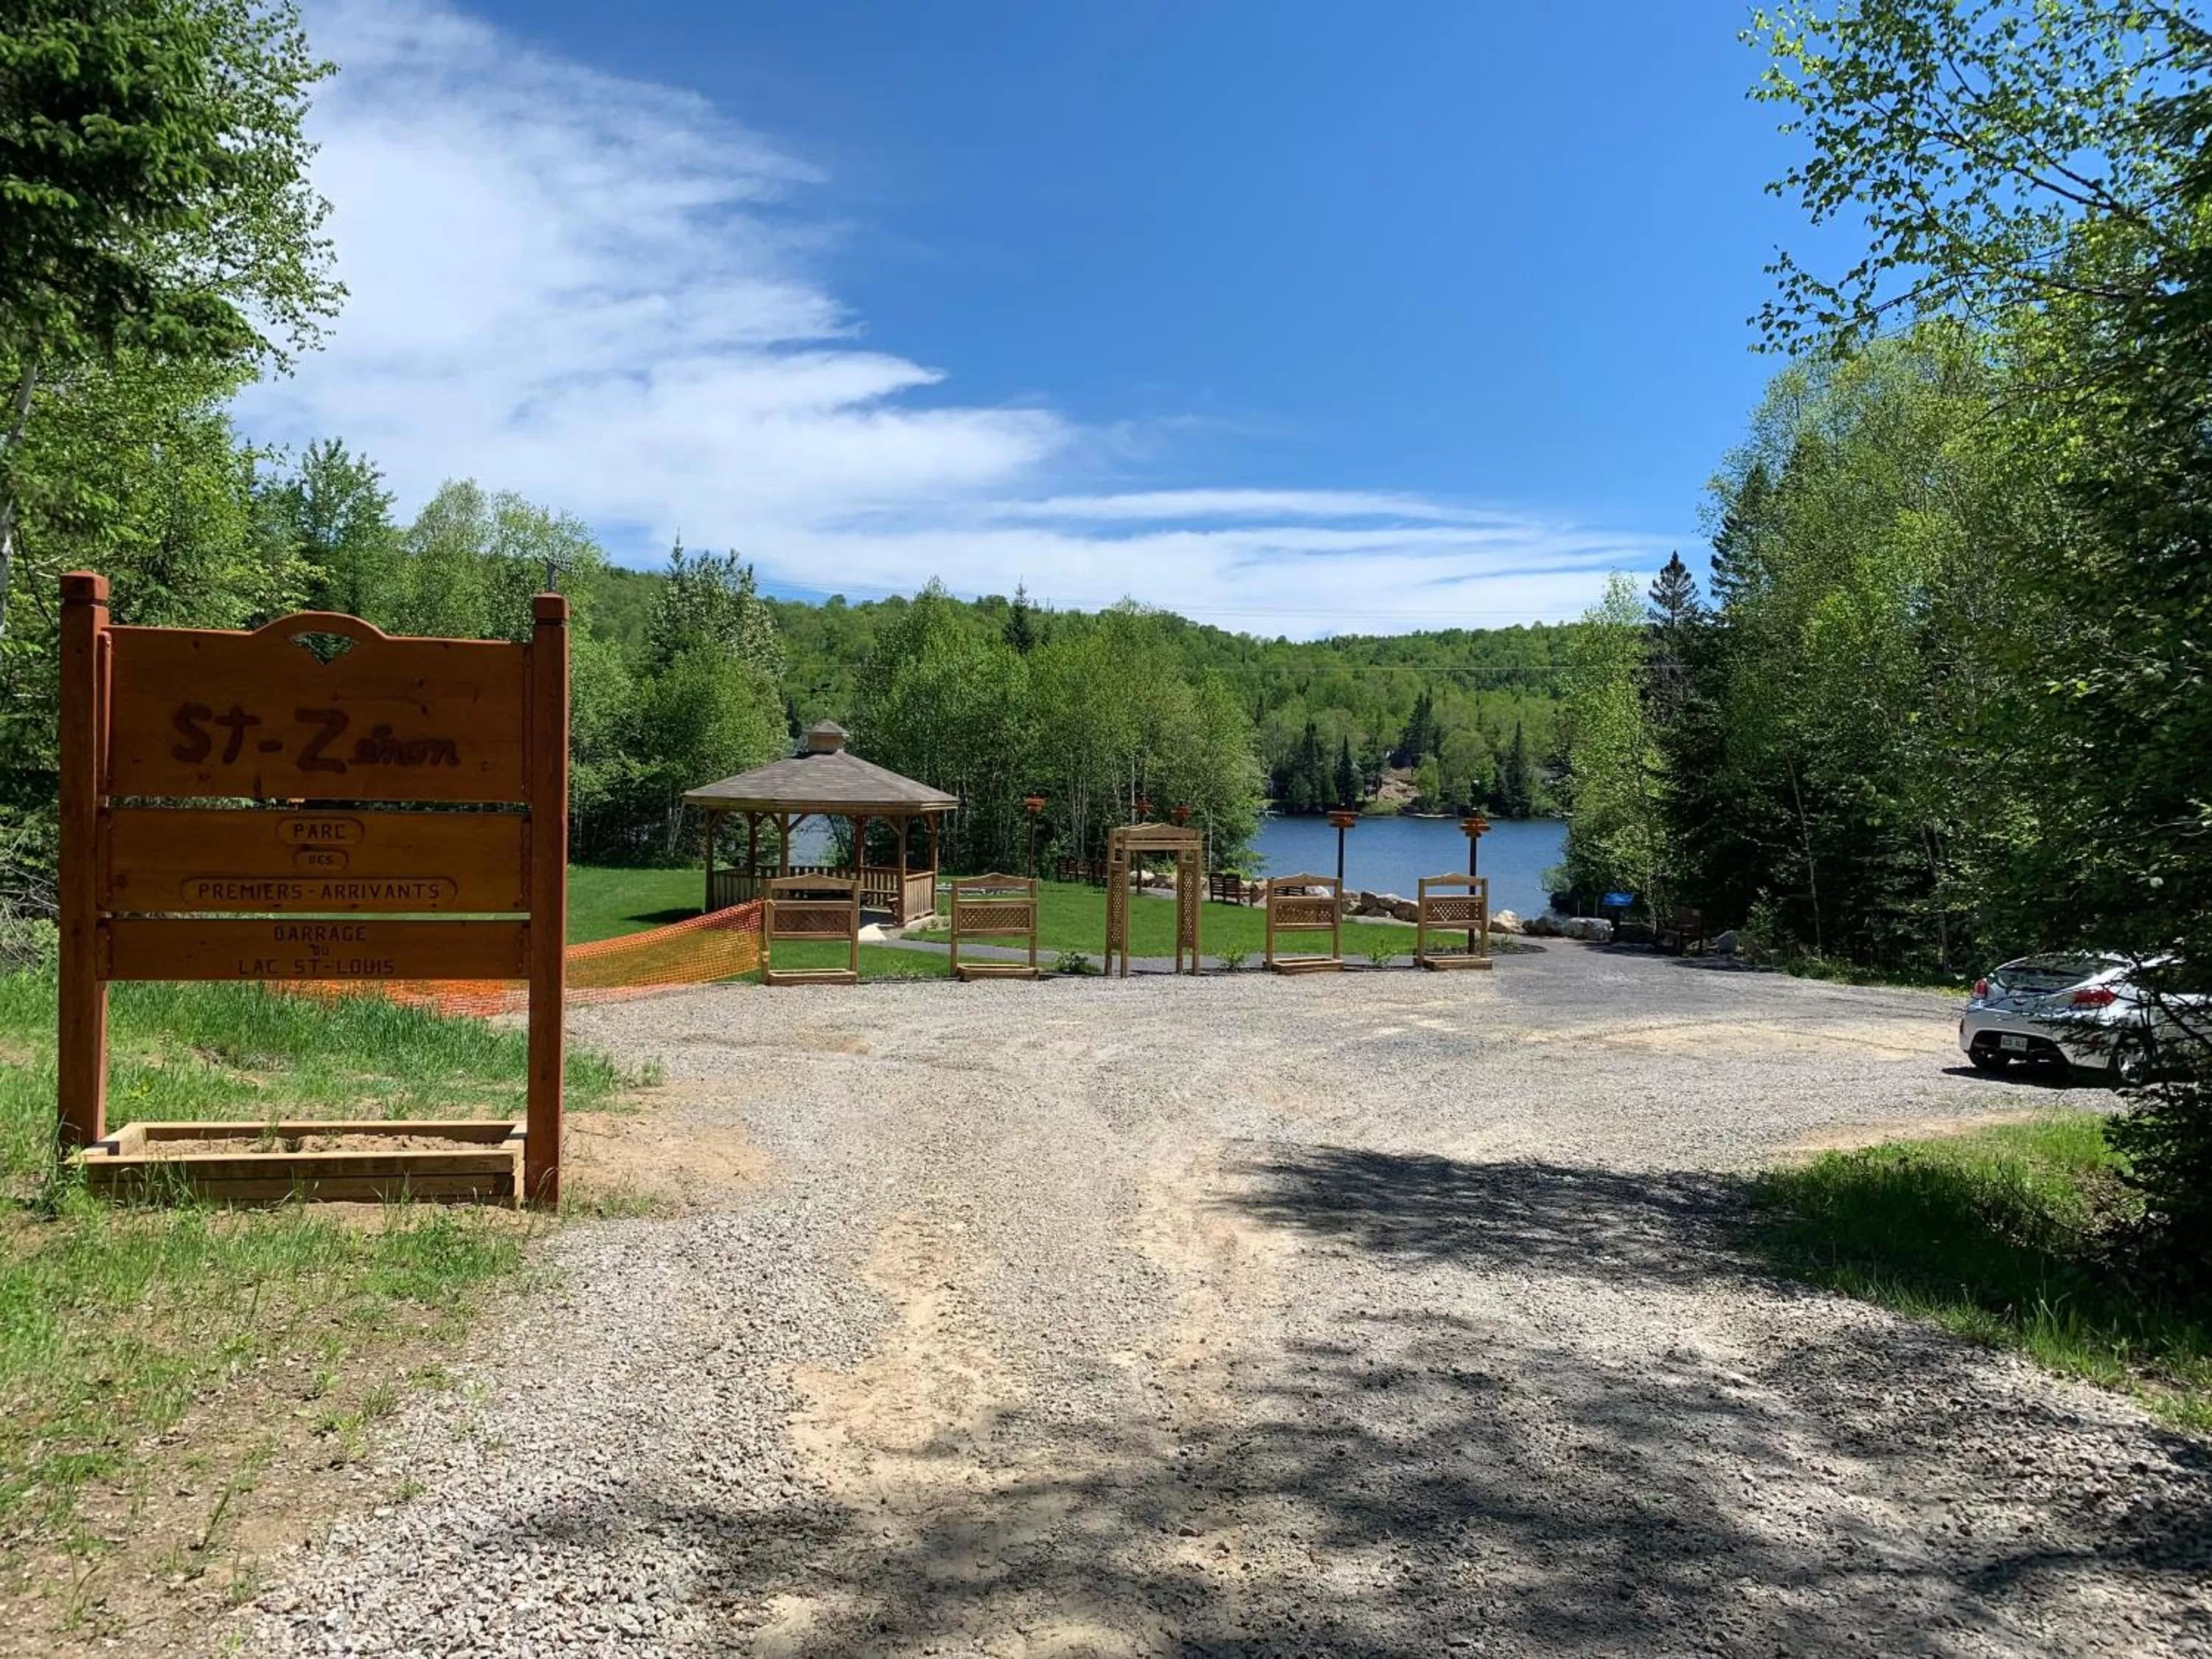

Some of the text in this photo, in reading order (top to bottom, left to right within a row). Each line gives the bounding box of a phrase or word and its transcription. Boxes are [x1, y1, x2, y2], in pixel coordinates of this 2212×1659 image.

[293, 823, 346, 838] PARC
[308, 855, 333, 865] DES
[238, 959, 395, 975] LAC ST-LOUIS
